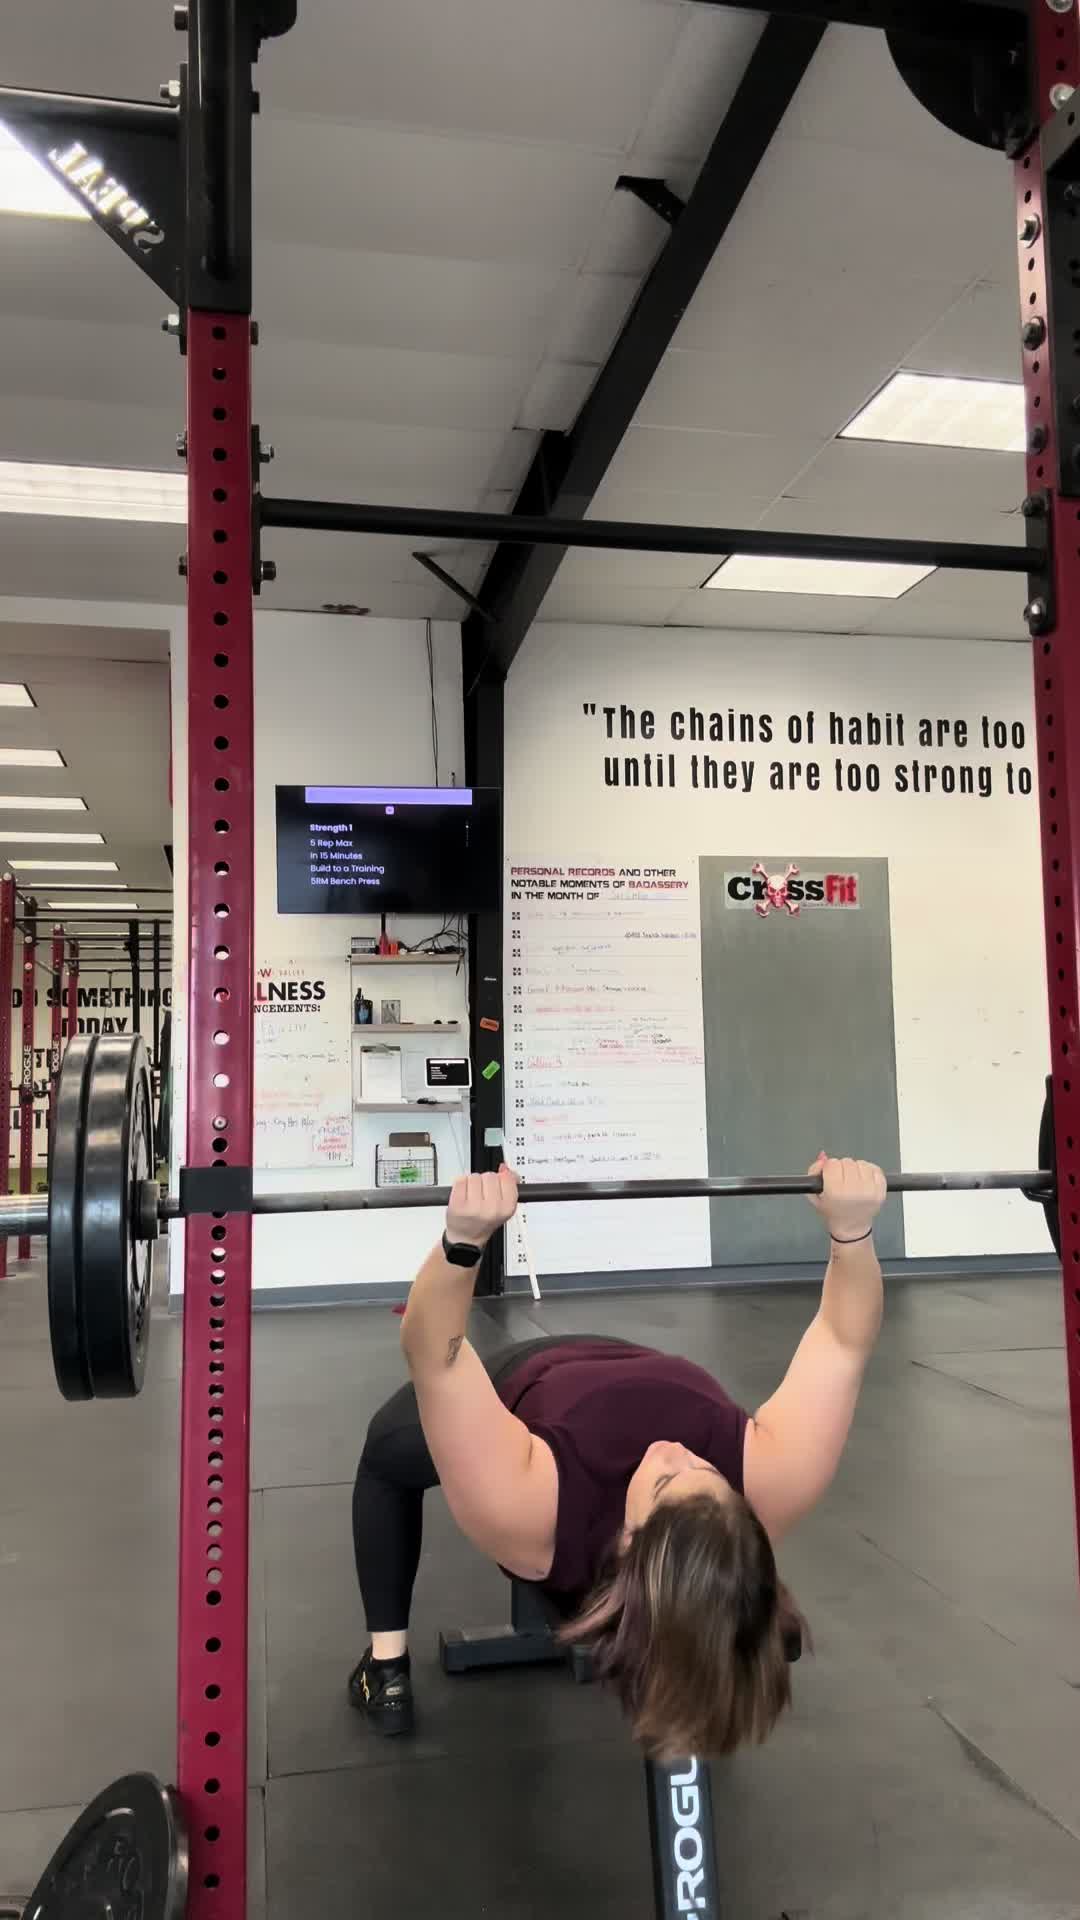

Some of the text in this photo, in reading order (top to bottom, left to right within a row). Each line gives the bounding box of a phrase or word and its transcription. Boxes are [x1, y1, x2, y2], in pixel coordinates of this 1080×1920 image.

[670, 708, 773, 744] chains
[787, 710, 815, 744] of
[829, 711, 905, 746] habit
[918, 717, 968, 748] are
[981, 715, 1025, 750] too
[604, 753, 1032, 797] until they are too strong to
[310, 824, 347, 834] Strength
[310, 839, 353, 848] 5 Rep Max
[319, 851, 329, 860] 15
[330, 852, 363, 861] Minutes
[310, 864, 331, 873] Build
[332, 865, 341, 873] to
[351, 864, 385, 875] Training
[511, 866, 677, 877] PERSONAL RECORDS AND OTHER
[310, 877, 380, 886] 5RM Bench Press
[511, 879, 689, 889] NOTABLE MOMENTS OF BADASSERY
[727, 875, 857, 904] CrssFit
[511, 891, 522, 900] IN
[525, 891, 544, 900] THE
[547, 891, 584, 900] MONTH
[586, 892, 600, 901] OF
[254, 980, 326, 1001] LNESS
[12, 988, 38, 1008] D
[24, 1045, 32, 1086] ROGUE
